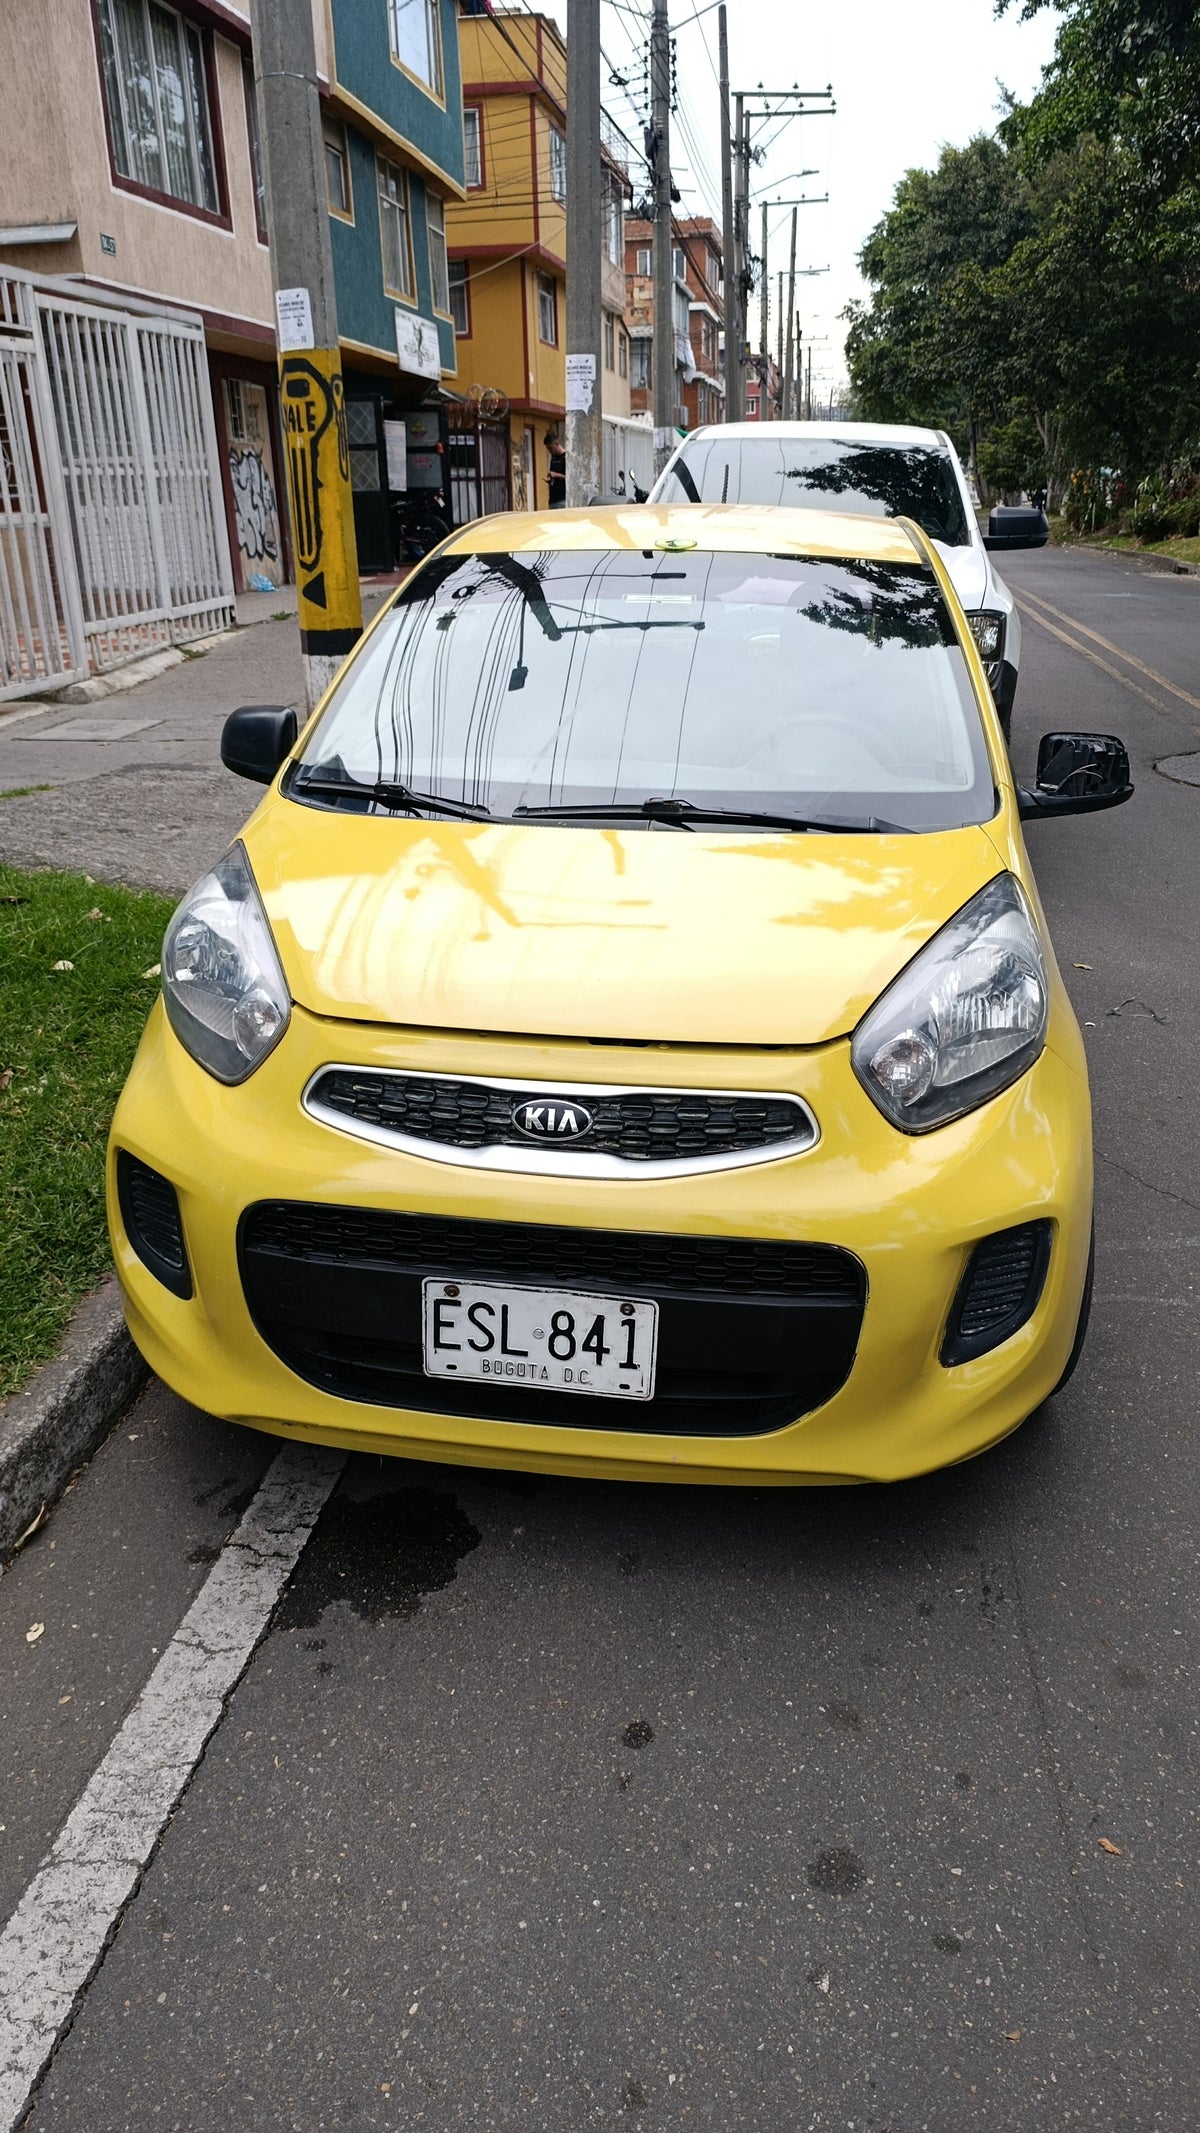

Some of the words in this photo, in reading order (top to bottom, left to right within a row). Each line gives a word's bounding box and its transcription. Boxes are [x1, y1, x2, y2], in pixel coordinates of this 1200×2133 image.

[525, 1106, 579, 1133] KIA
[433, 1298, 529, 1358] ESL
[547, 1310, 638, 1370] 841
[482, 1358, 550, 1380] BOGOTA
[564, 1367, 594, 1386] D.C.
